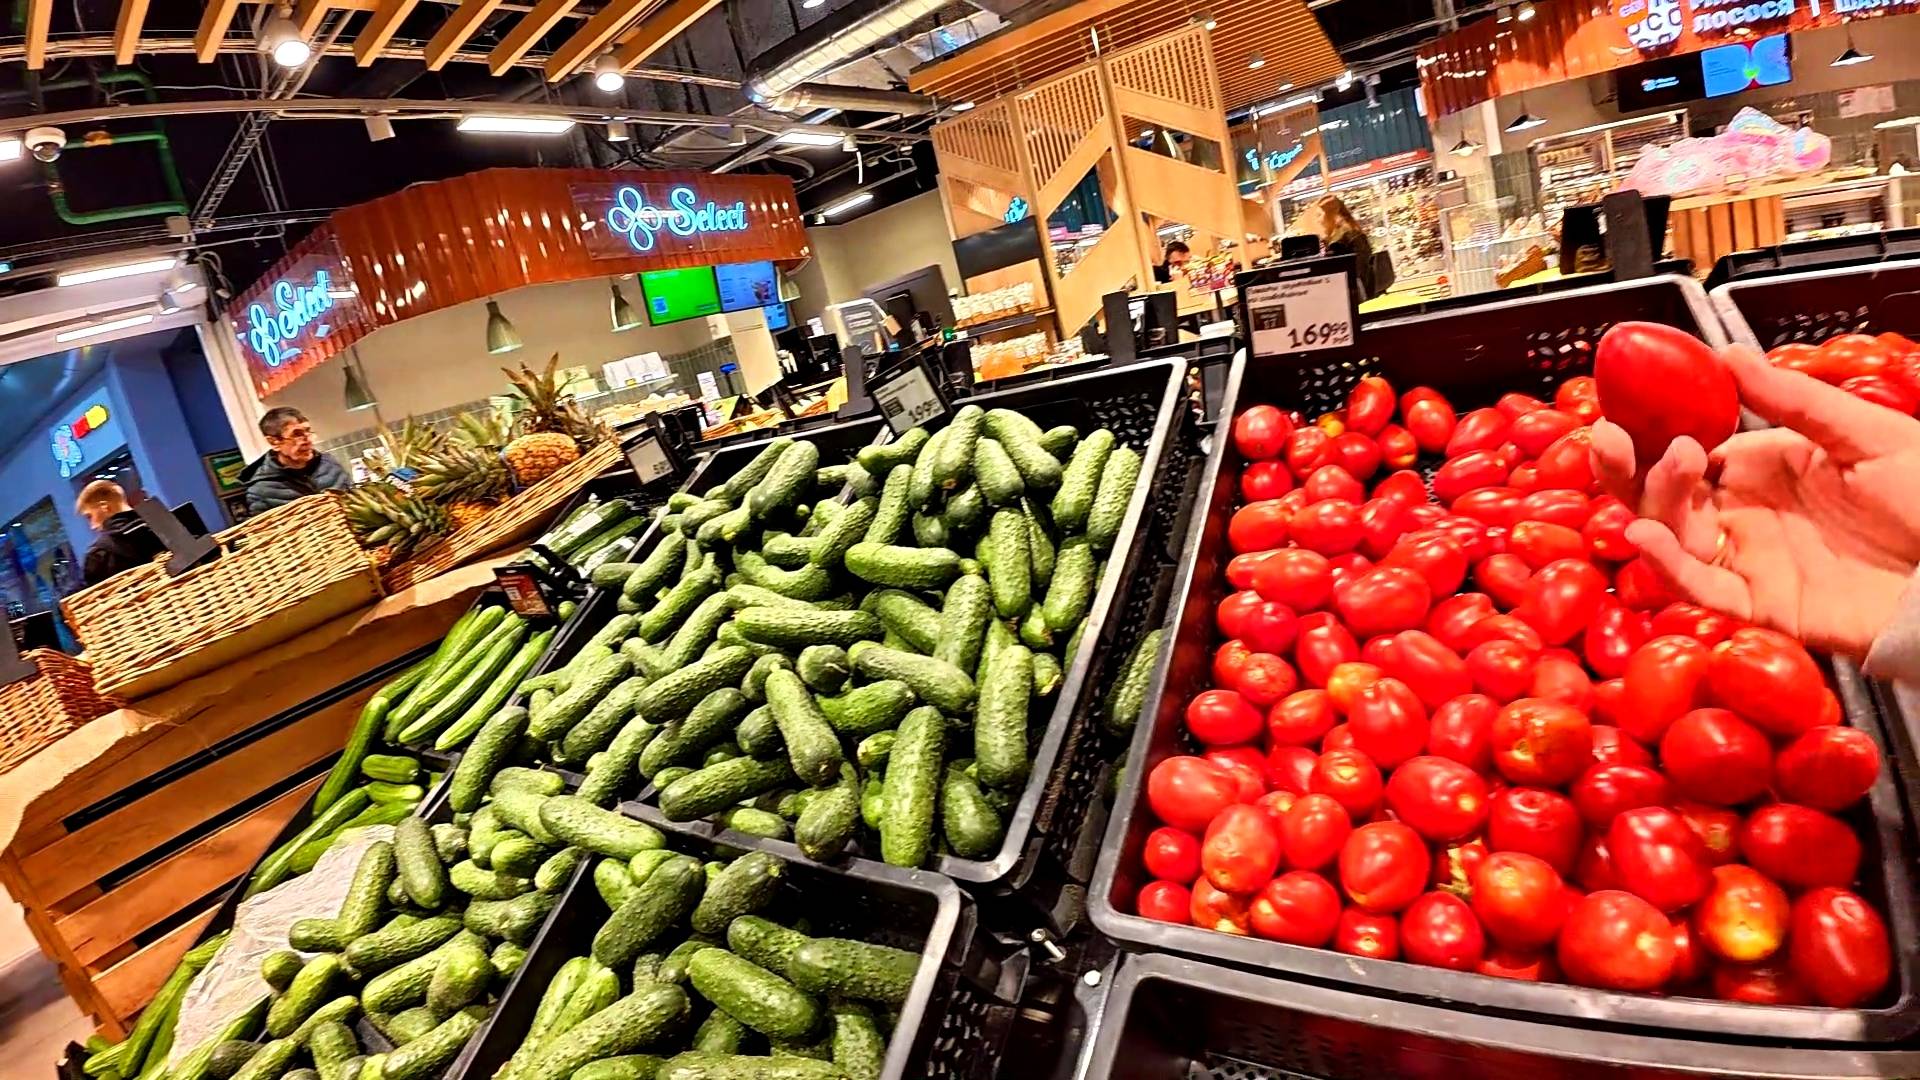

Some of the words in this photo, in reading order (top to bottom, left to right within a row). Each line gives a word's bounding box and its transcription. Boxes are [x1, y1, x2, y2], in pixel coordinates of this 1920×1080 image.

[668, 187, 748, 236] Select
[276, 270, 333, 339] Select
[1287, 322, 1332, 349] 169
